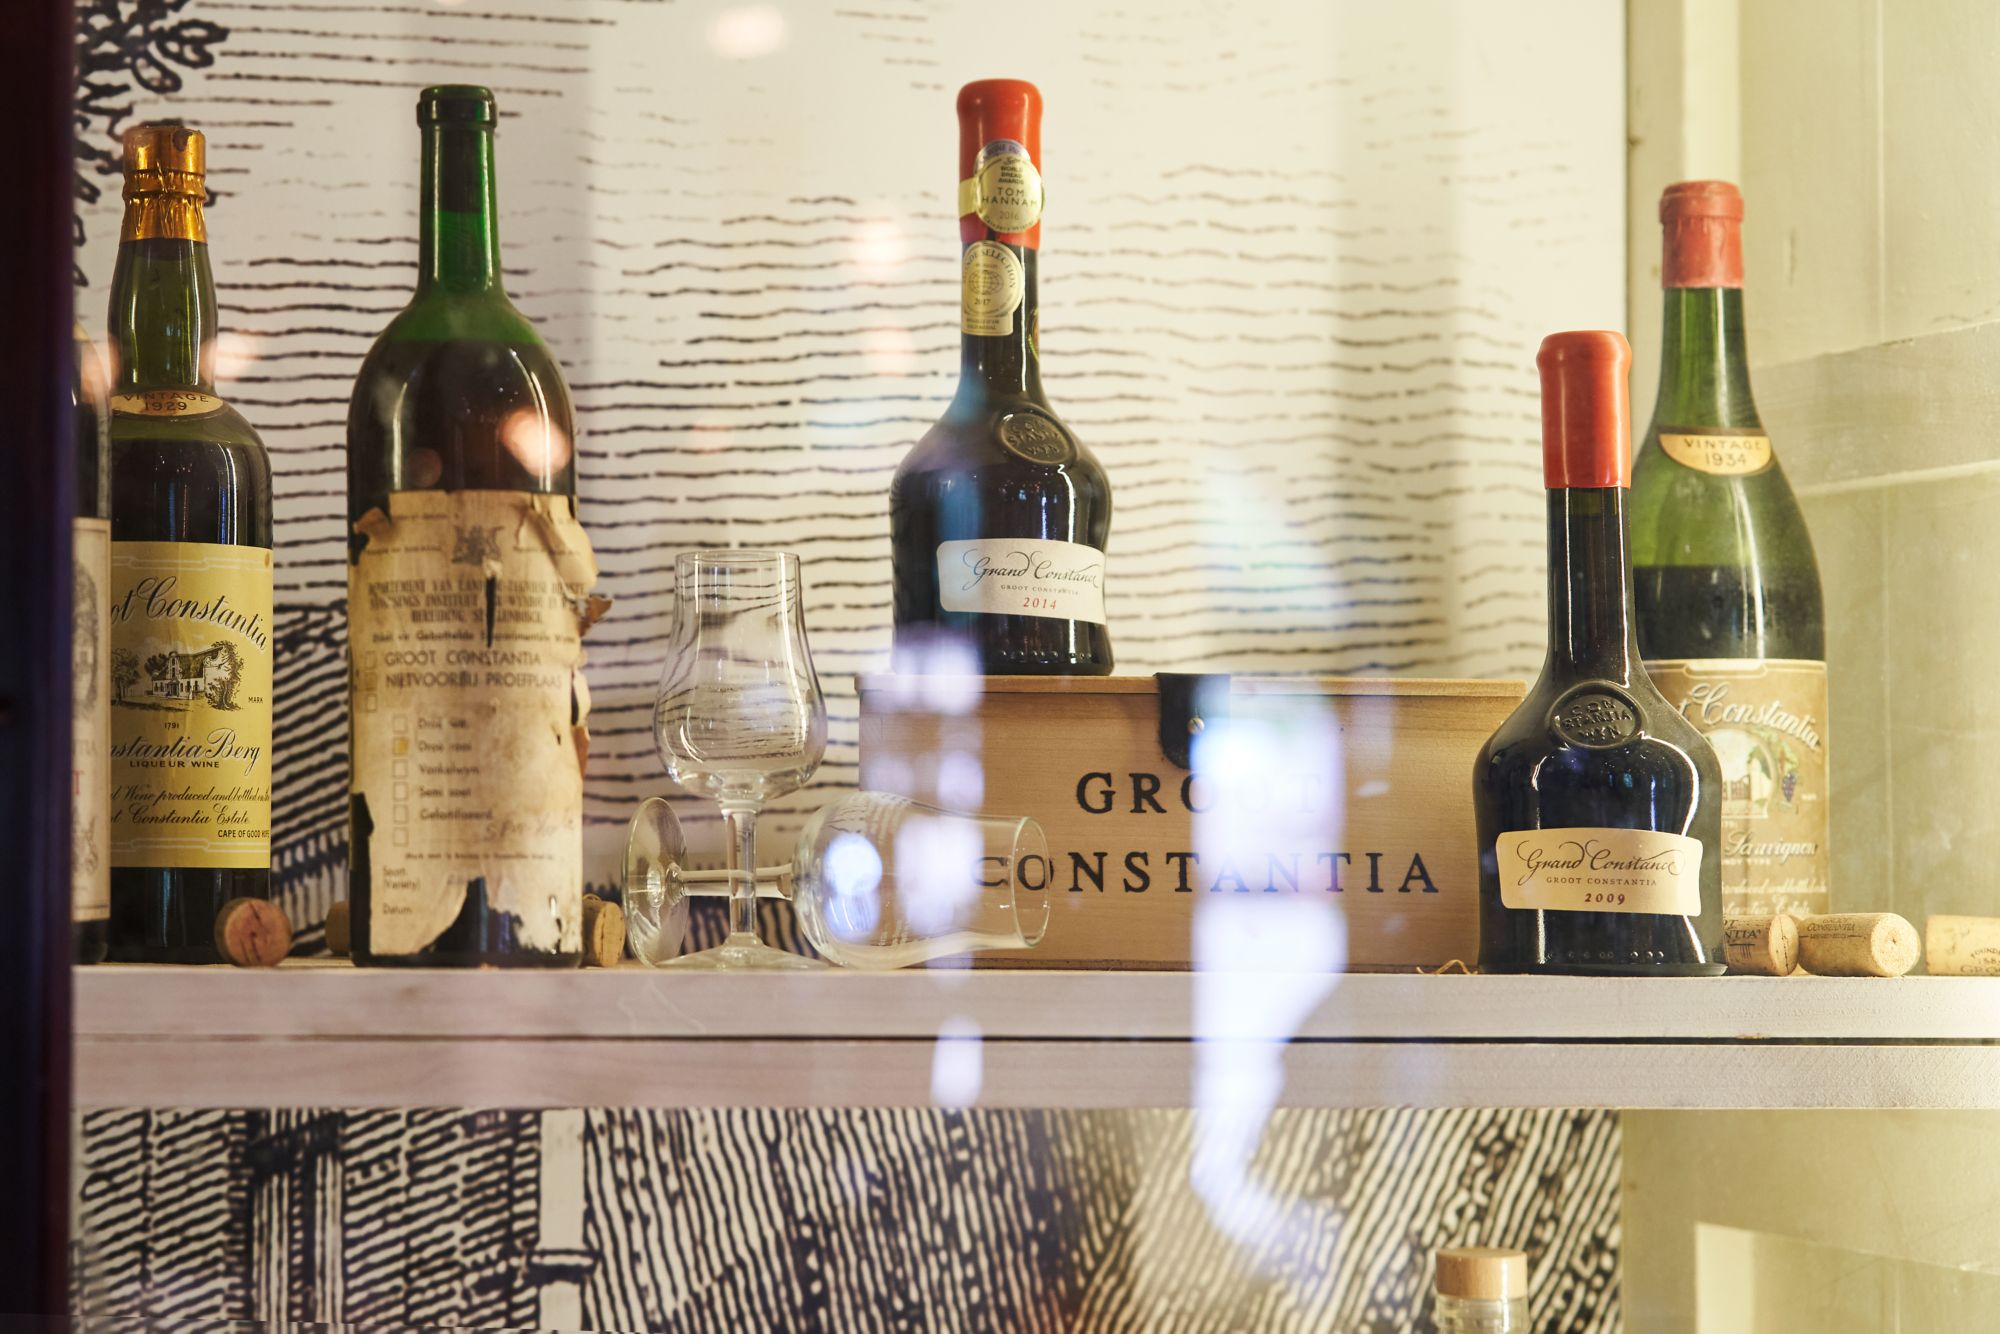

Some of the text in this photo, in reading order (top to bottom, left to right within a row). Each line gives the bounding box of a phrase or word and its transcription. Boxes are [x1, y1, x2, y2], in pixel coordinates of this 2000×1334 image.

[997, 187, 1024, 197] TOM
[123, 392, 209, 403] VINTAGE
[144, 401, 187, 411] 1929
[1684, 438, 1762, 450] VINTAGE
[1705, 453, 1747, 467] 1934
[962, 548, 1030, 591] Grand
[1023, 597, 1058, 610] 2014
[136, 575, 267, 650] Constantia
[384, 650, 542, 666] GROOT CONSTANTIA
[248, 696, 264, 704] MARK
[1688, 681, 1821, 751] Constantia
[164, 722, 180, 731] 1791
[204, 727, 261, 776] Berg
[130, 760, 185, 768] LIQUEUR
[153, 785, 215, 806] produced
[128, 803, 211, 825] Constantia
[212, 803, 249, 825] Estate
[217, 829, 236, 838] CAPE
[238, 829, 246, 838] OF
[1516, 839, 1684, 886] Grand Constance
[970, 850, 1440, 893] CONSTANTIA
[1546, 877, 1657, 886] GROOT CONSTANTIA
[1584, 893, 1626, 905] 2009
